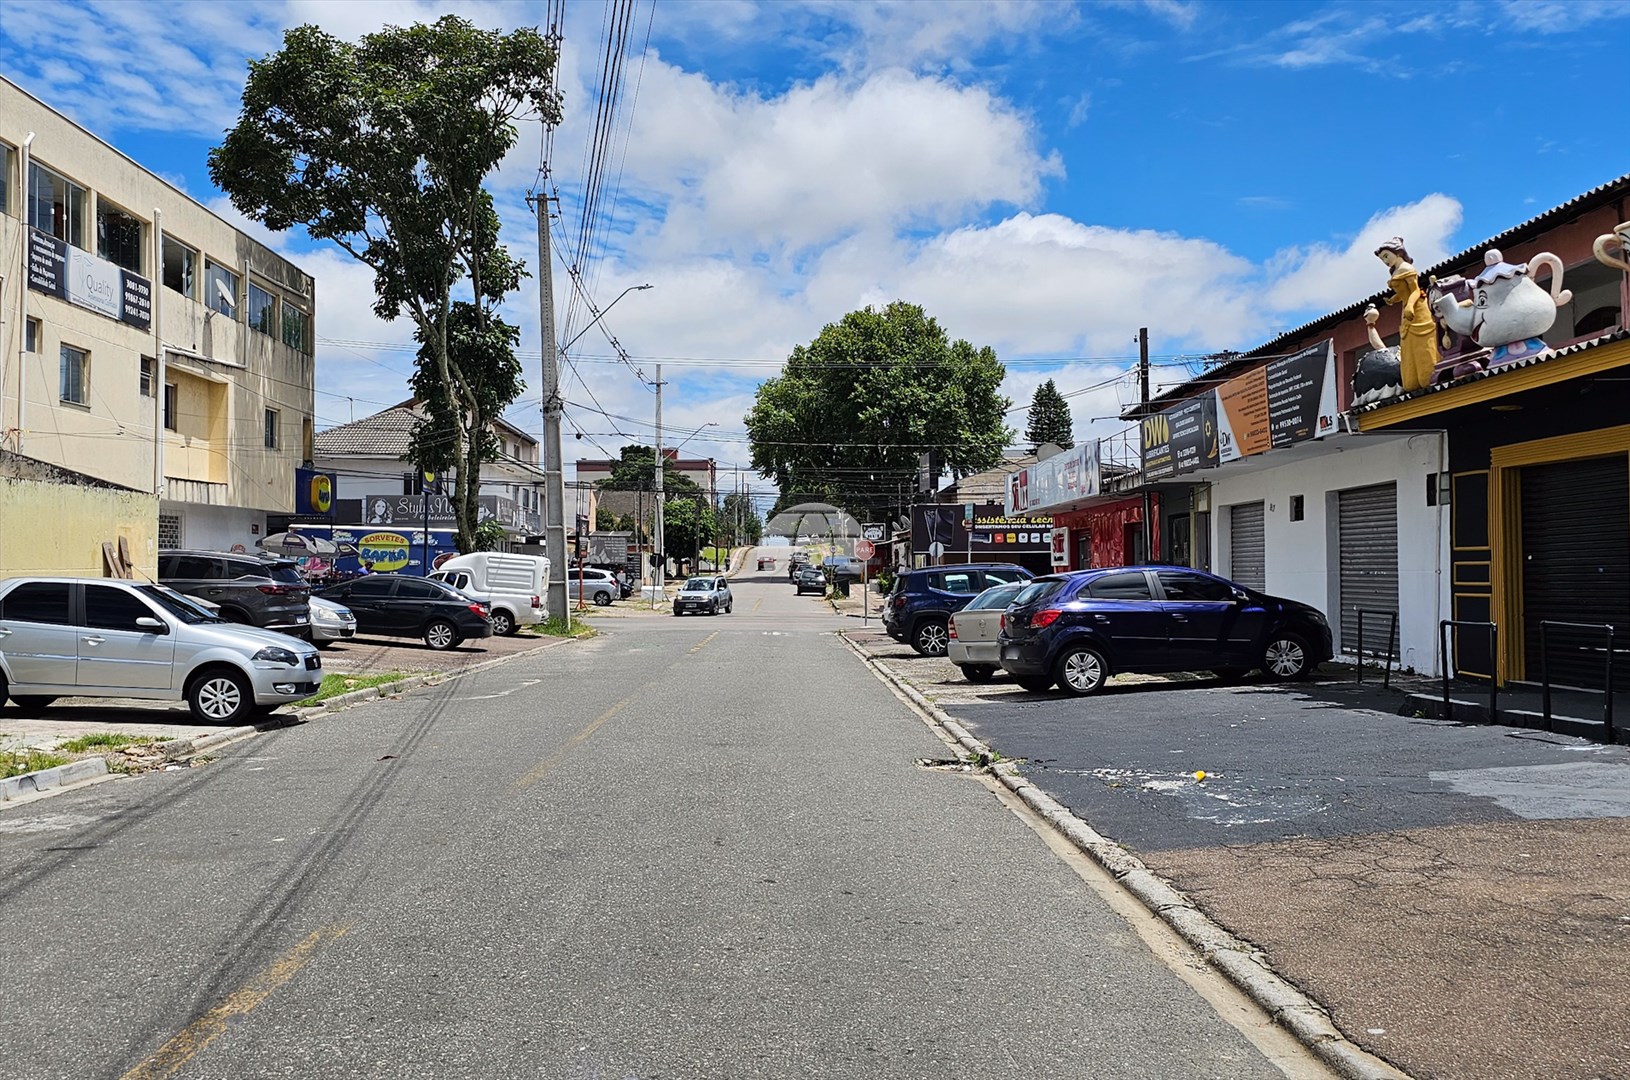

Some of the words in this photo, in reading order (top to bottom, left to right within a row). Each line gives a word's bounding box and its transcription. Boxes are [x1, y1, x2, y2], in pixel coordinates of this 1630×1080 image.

[86, 274, 114, 301] Quality
[1144, 414, 1163, 449] DW
[364, 533, 405, 545] SORVETES
